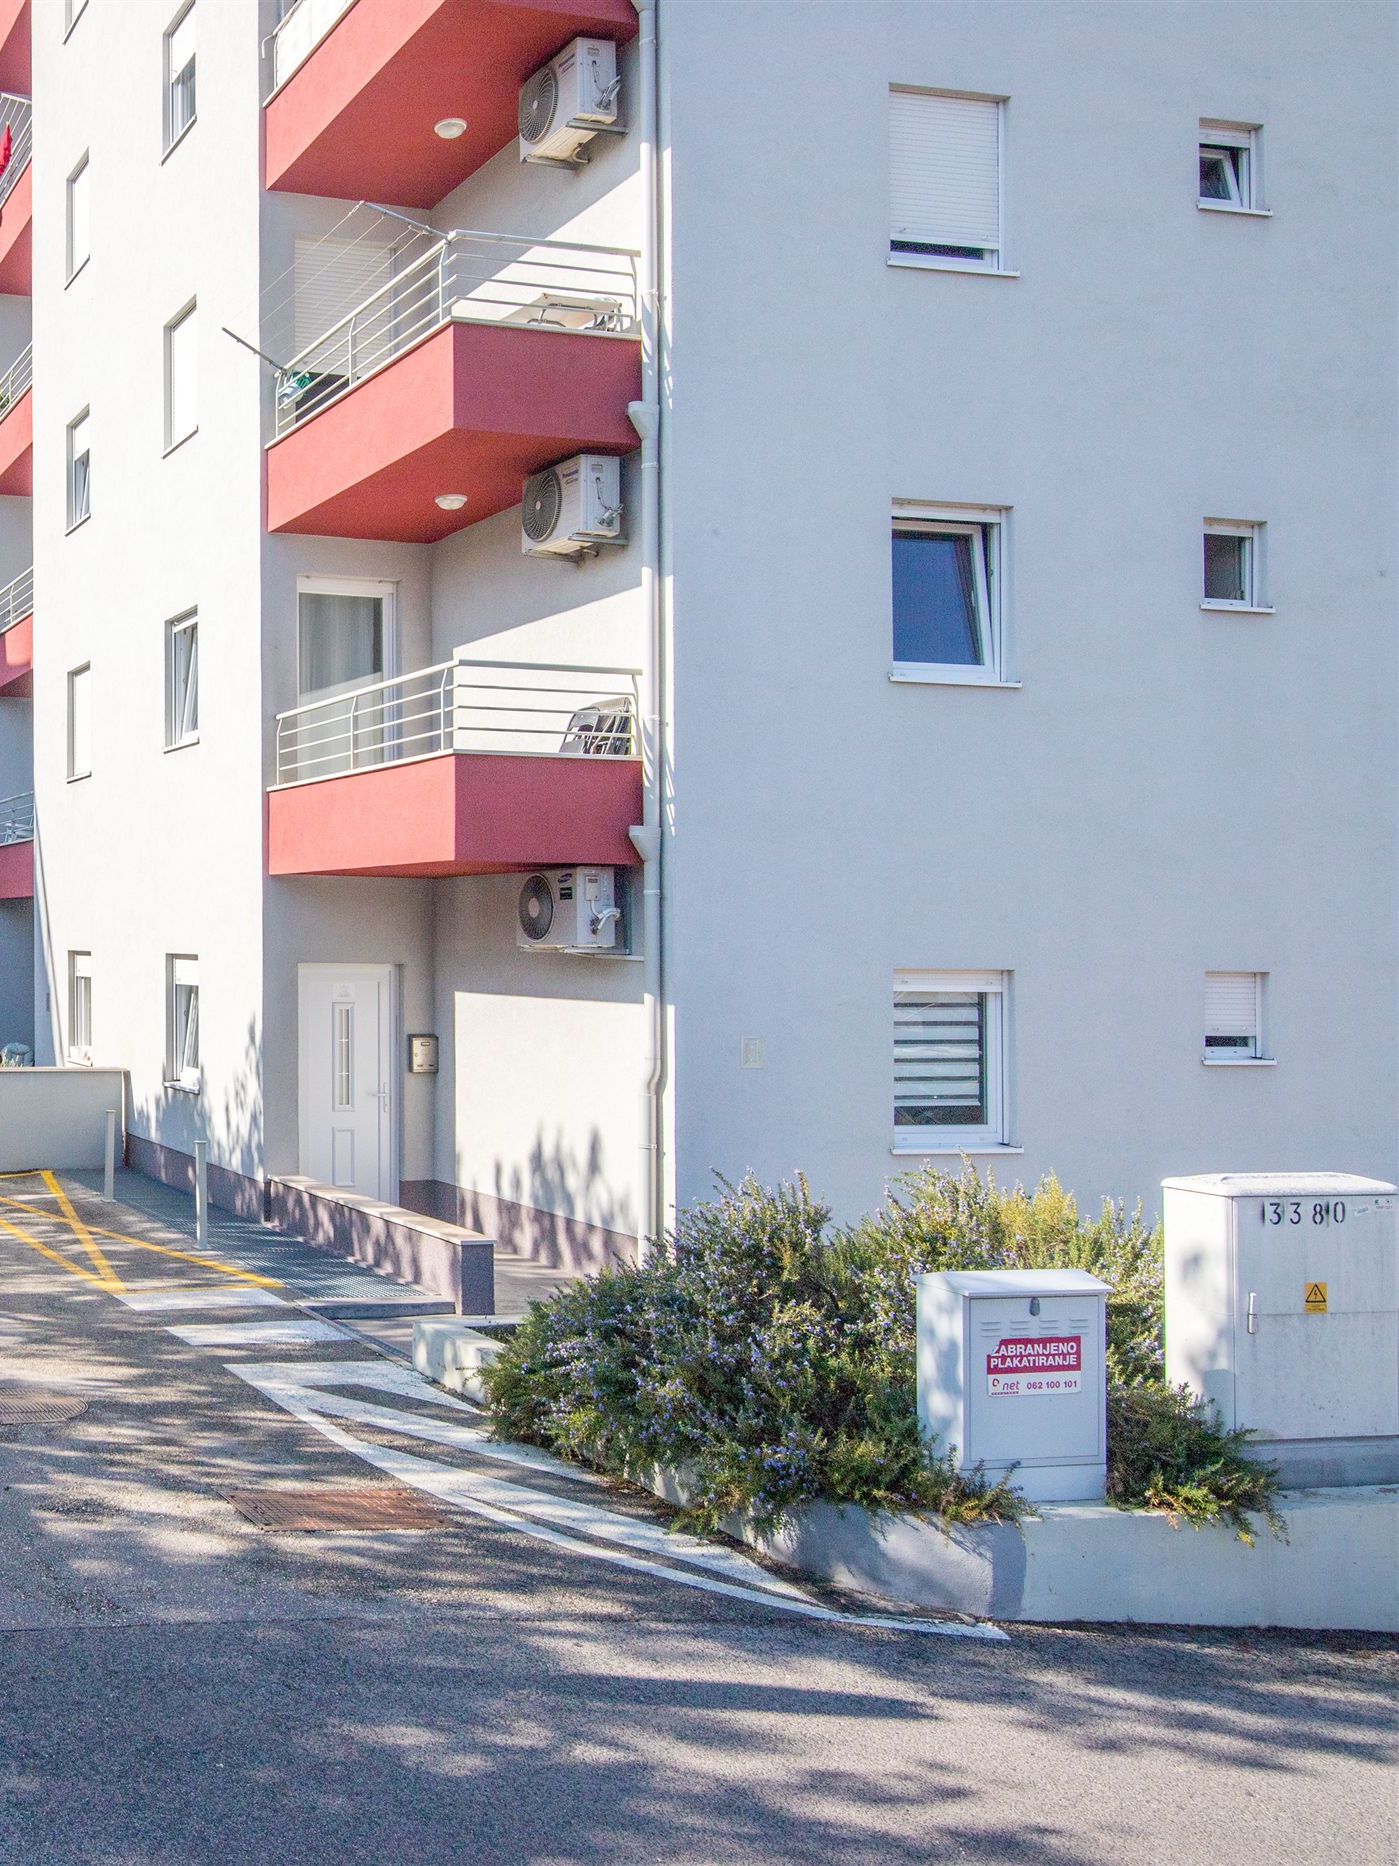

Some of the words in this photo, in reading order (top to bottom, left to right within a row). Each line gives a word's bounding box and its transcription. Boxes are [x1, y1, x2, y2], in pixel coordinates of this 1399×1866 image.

[990, 1355, 1078, 1368] PLAKATIRANJE
[1026, 1381, 1043, 1390] 062
[1046, 1381, 1060, 1389] 100
[1063, 1380, 1077, 1388] 101
